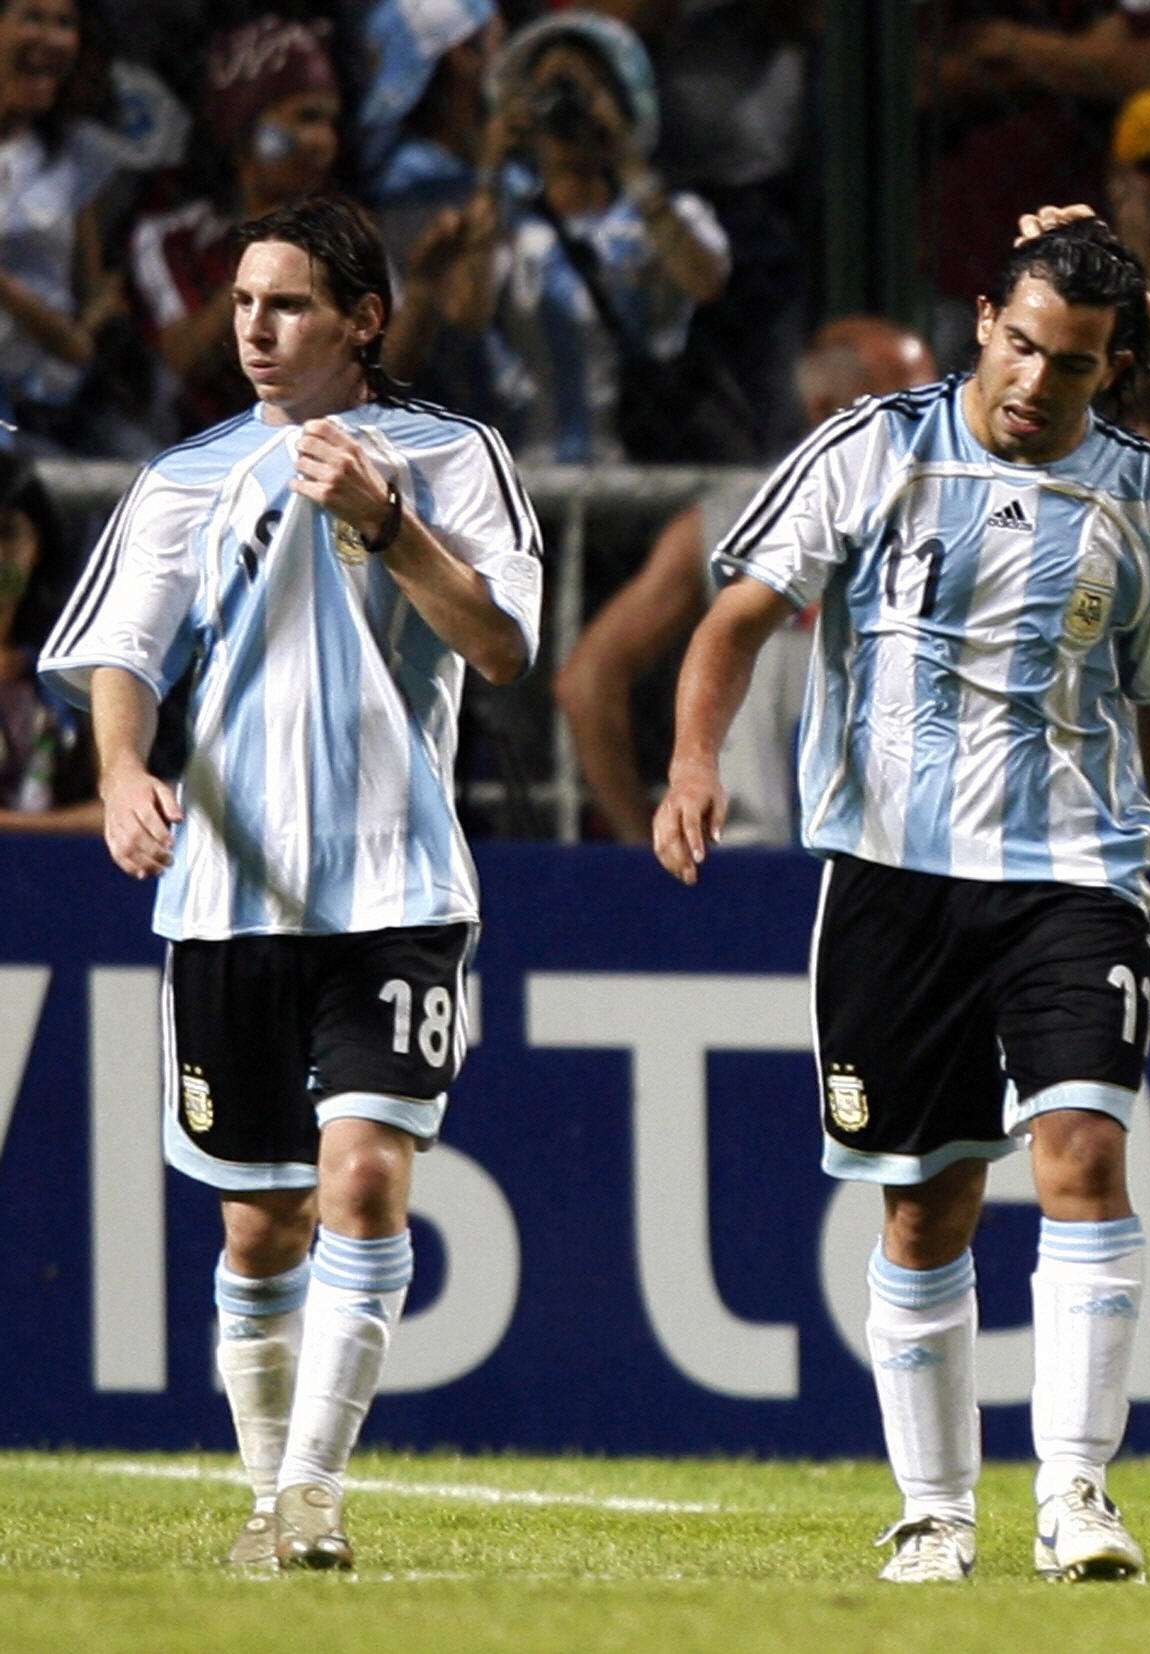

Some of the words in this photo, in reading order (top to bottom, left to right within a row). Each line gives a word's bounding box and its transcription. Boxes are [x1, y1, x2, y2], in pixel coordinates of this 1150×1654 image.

[986, 517, 1033, 532] adidas
[884, 529, 946, 619] 11
[378, 978, 452, 1068] 18
